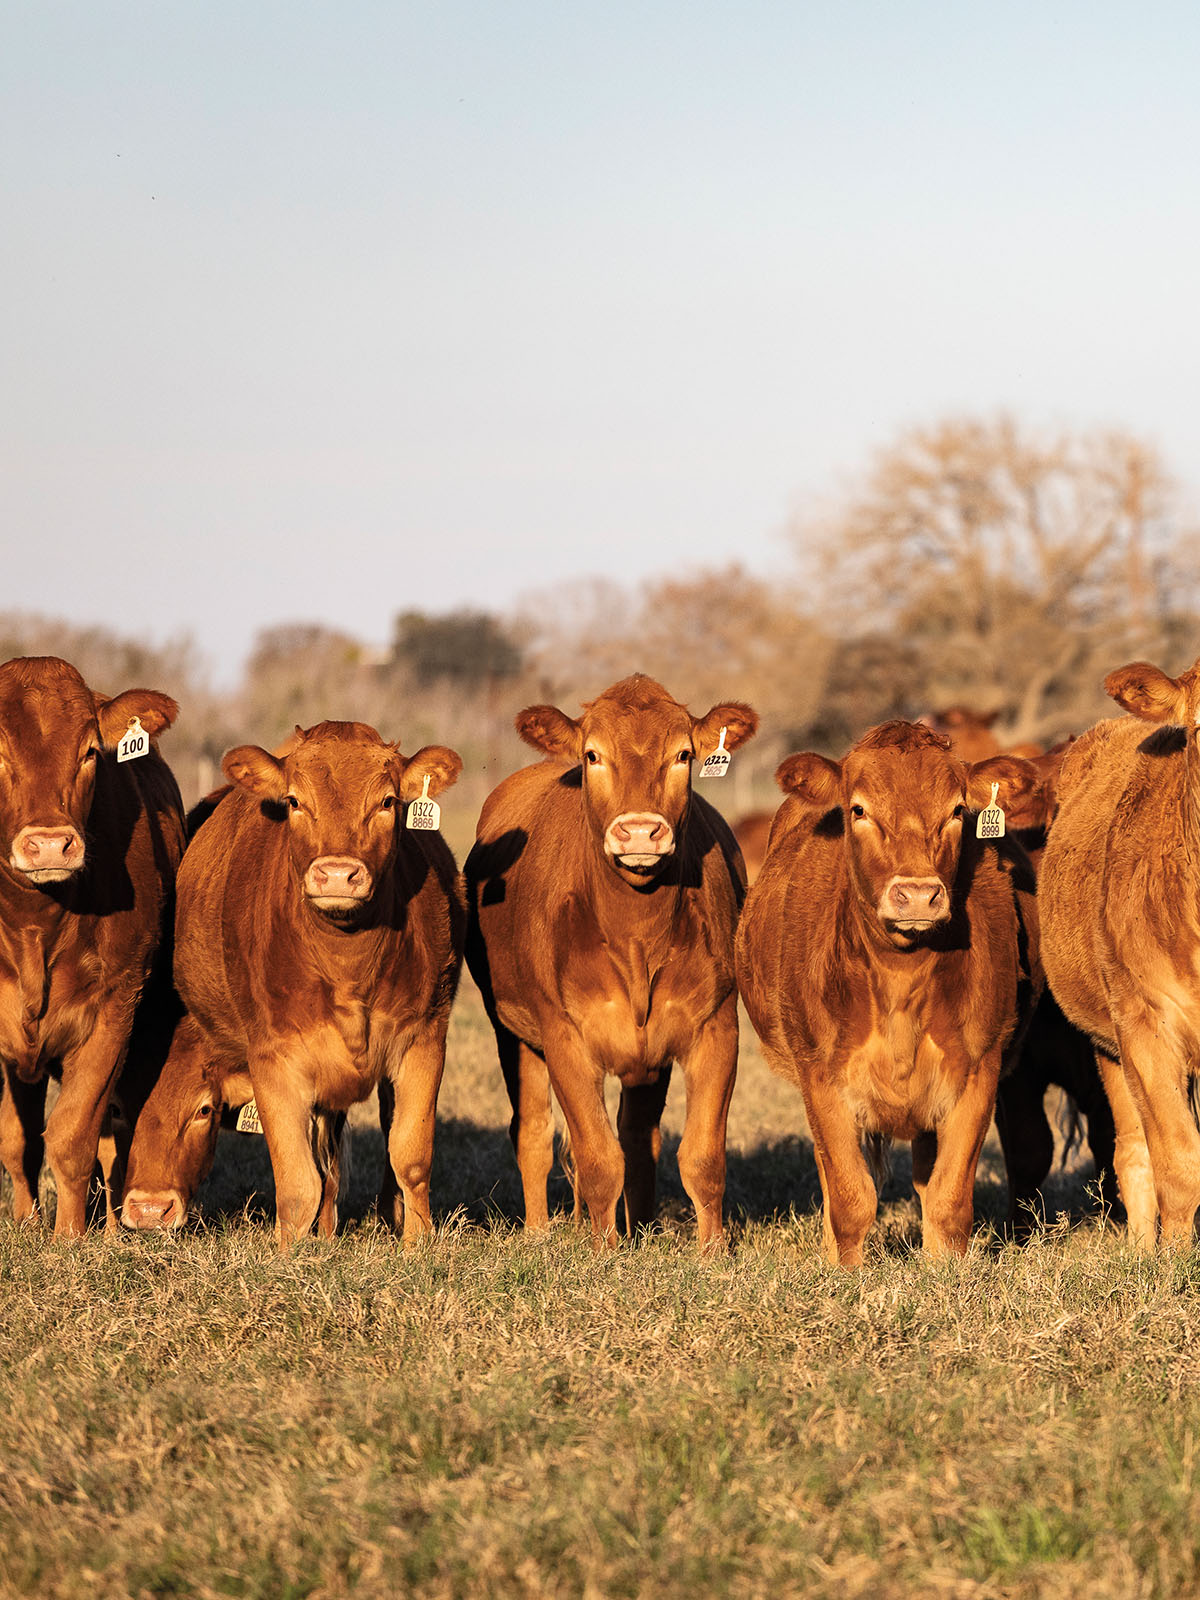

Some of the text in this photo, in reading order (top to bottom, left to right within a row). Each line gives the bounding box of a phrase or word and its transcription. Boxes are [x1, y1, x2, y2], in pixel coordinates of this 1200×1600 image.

[122, 737, 144, 756] 100
[704, 755, 729, 766] 0322
[412, 802, 434, 817] 0322
[981, 809, 1000, 824] 0322
[412, 818, 434, 829] 8869
[981, 825, 1000, 837] 8999
[243, 1105, 259, 1120] 032
[241, 1119, 259, 1131] 8941
